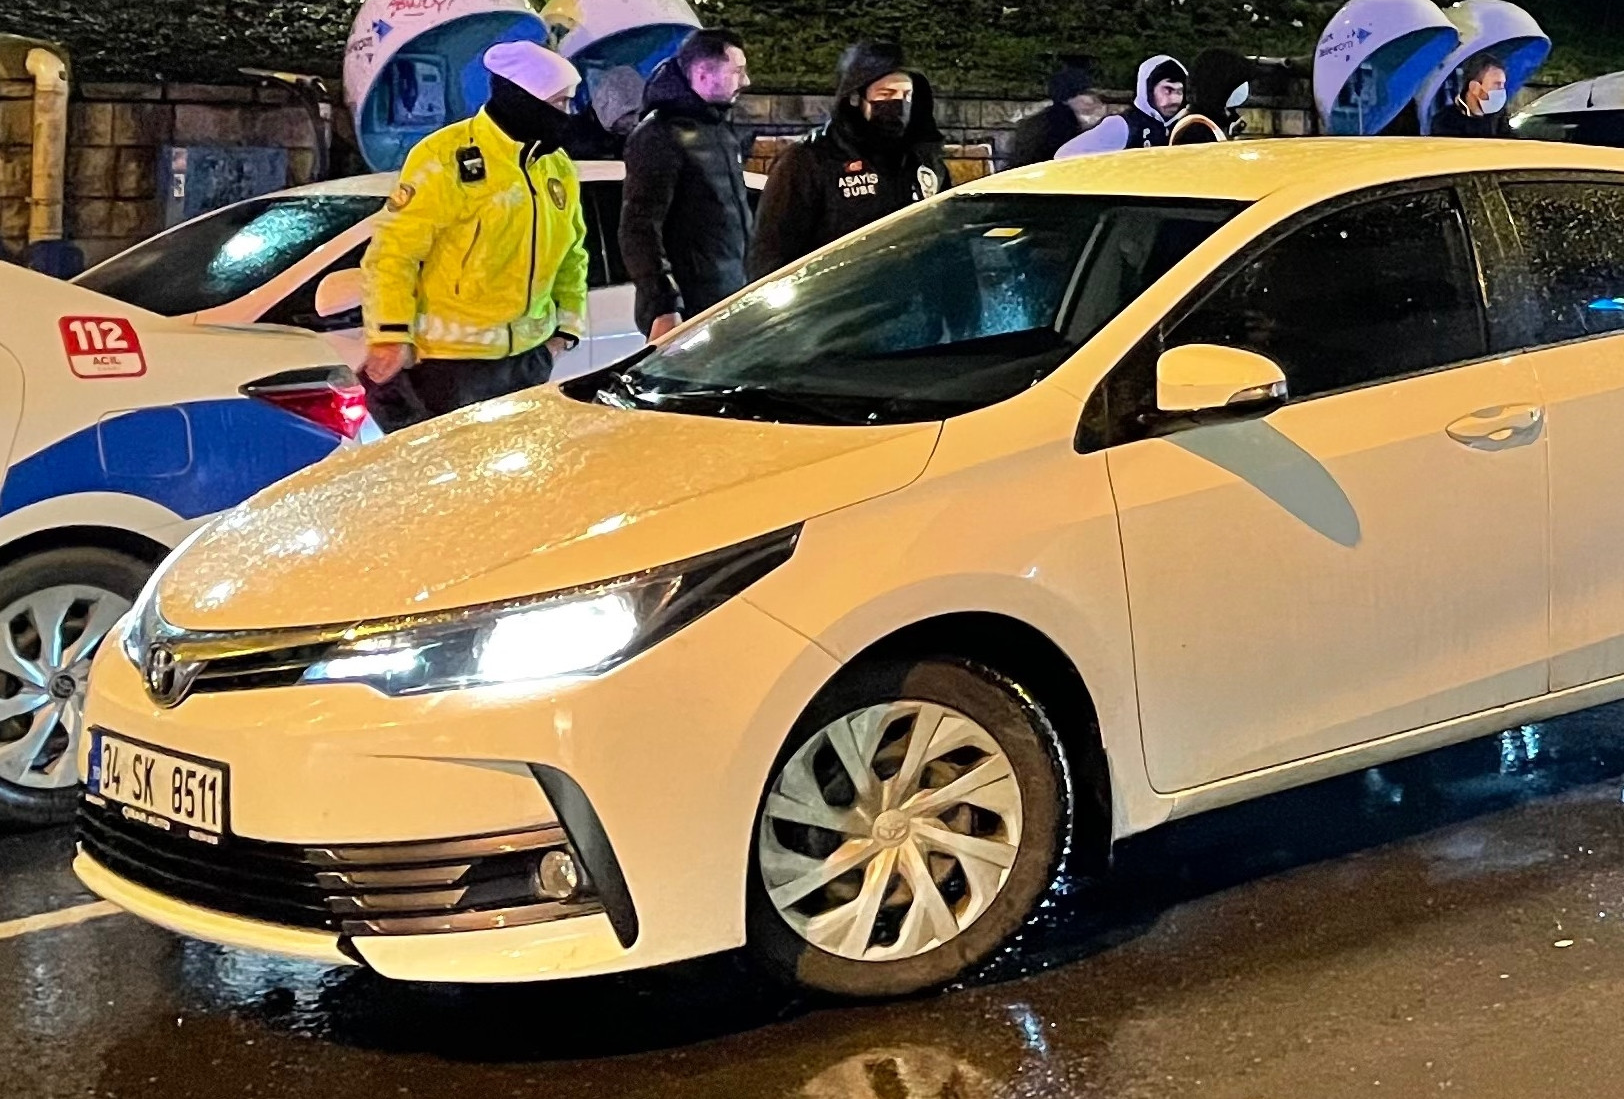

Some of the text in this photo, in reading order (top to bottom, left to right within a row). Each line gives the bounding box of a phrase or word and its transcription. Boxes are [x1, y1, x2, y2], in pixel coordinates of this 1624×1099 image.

[69, 320, 129, 351] 112
[103, 743, 121, 795] 34
[132, 753, 156, 807] SK
[171, 766, 217, 825] 8511
